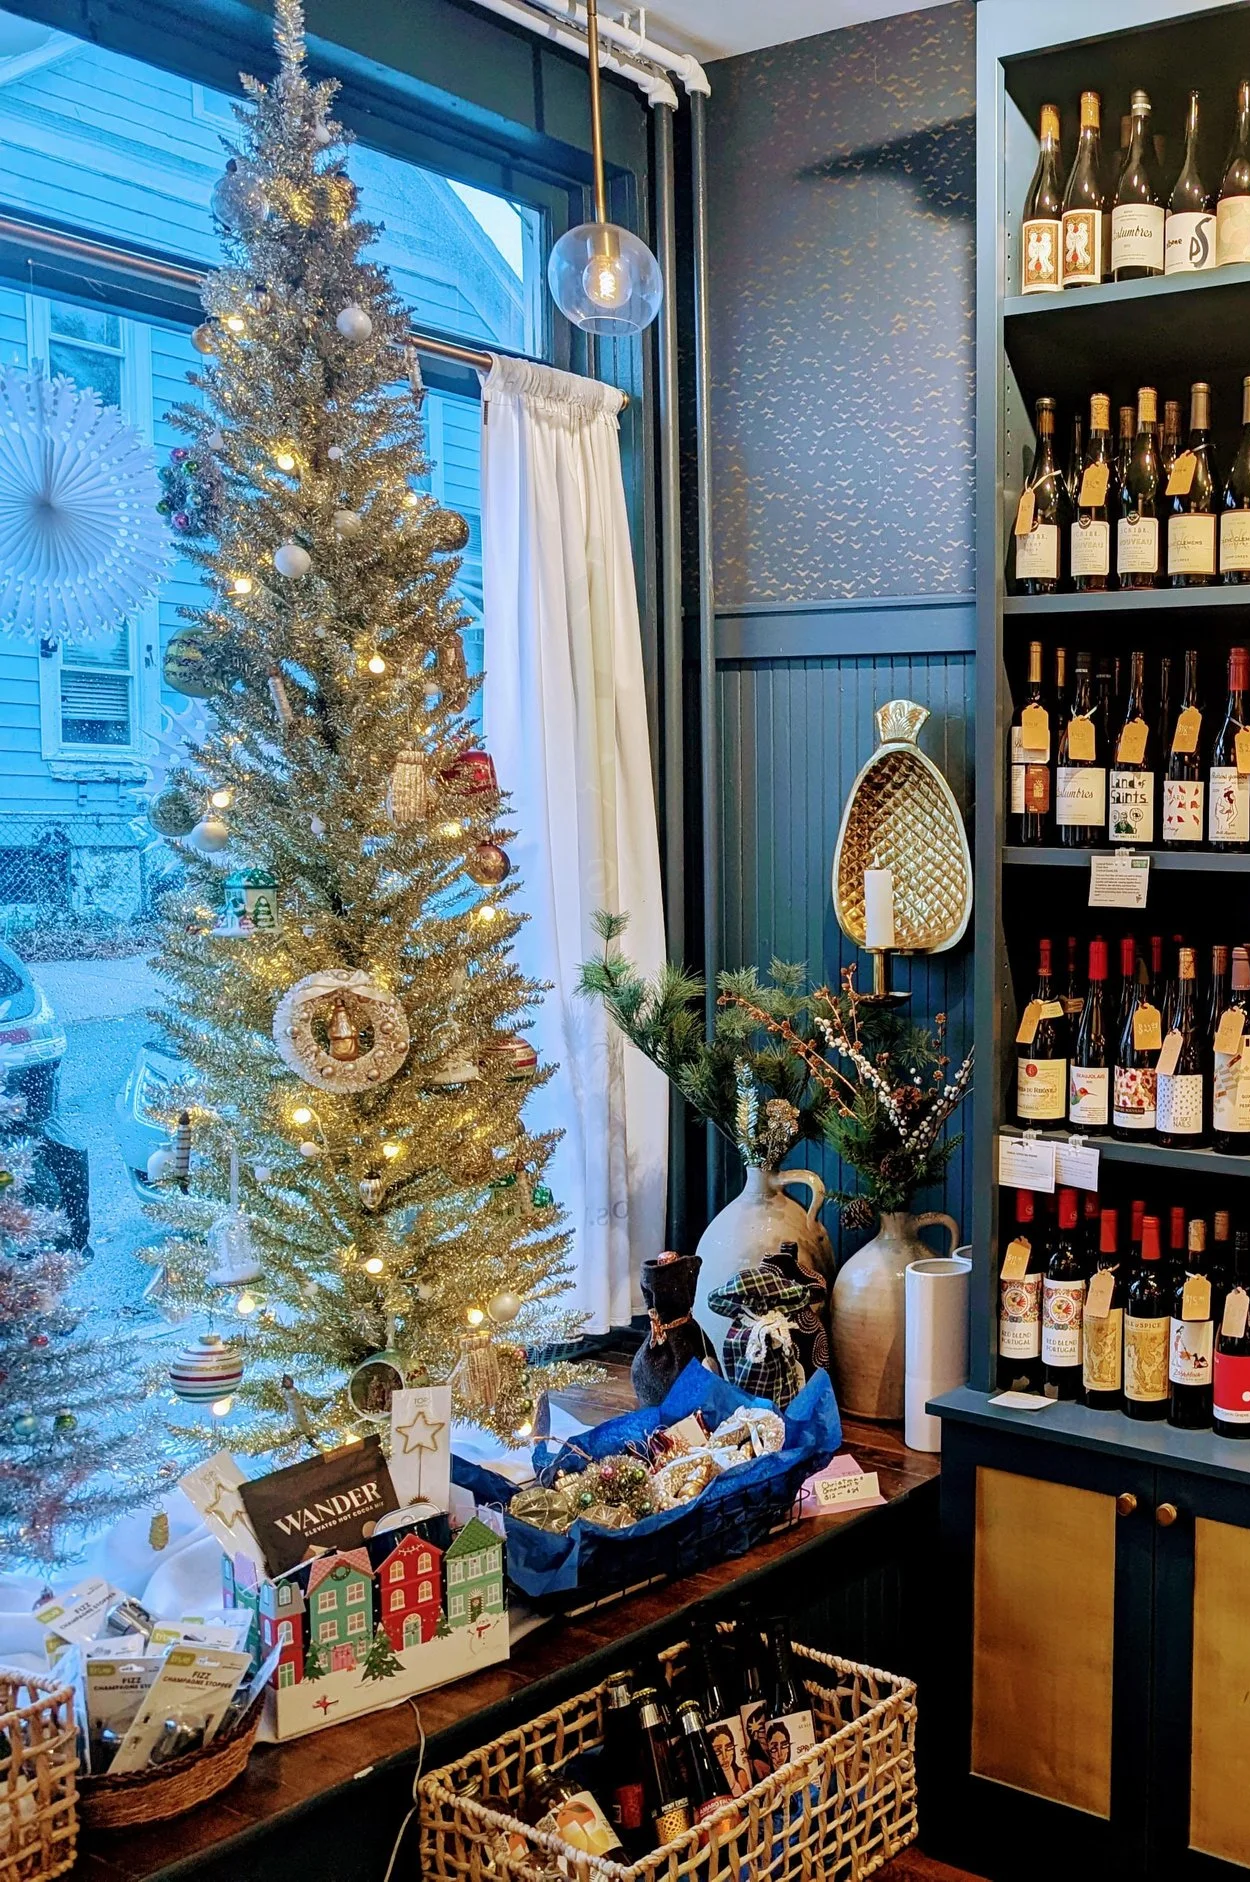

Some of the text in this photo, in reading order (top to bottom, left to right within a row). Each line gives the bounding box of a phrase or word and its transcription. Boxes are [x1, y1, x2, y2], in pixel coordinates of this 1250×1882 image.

[1111, 776, 1136, 789] Land
[1110, 790, 1150, 804] Saints
[1011, 1331, 1032, 1339] BLEND
[273, 1480, 383, 1537] WANDER
[304, 1518, 338, 1538] ELEVATED
[338, 1513, 353, 1524] HOT
[352, 1505, 374, 1519] COCOA
[74, 1601, 90, 1615] FIZZ
[122, 1676, 142, 1684] FIZZ
[192, 1671, 212, 1679] FIZZ
[93, 1684, 139, 1692] CHAMPAGNE
[162, 1675, 233, 1689] CHAMPAGNE STOPPER
